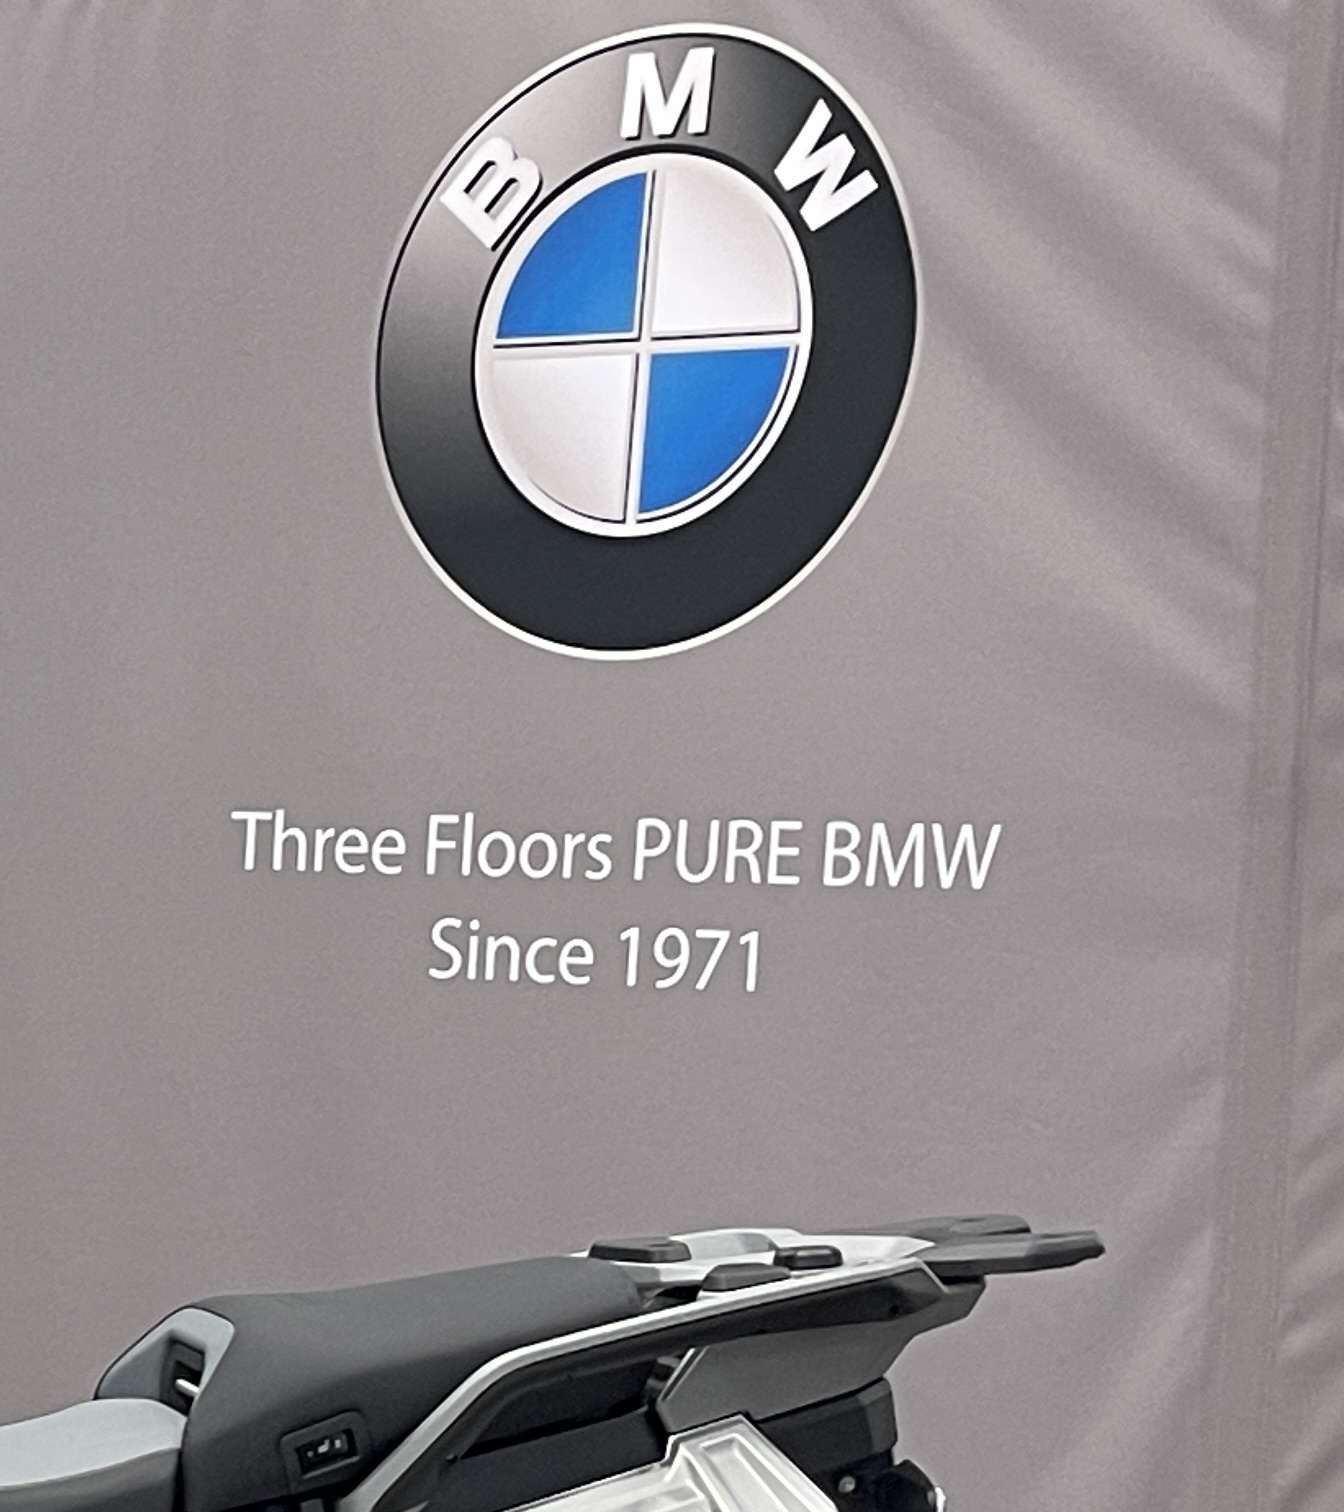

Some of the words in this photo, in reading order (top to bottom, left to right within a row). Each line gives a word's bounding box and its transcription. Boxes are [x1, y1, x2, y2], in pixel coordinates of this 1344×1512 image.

[439, 46, 879, 251] BMW
[230, 808, 407, 876] Three
[425, 810, 613, 881] Floors
[632, 816, 804, 886] PURE
[822, 820, 1003, 891] BMW
[427, 916, 595, 986] Since
[619, 926, 760, 993] 1971
